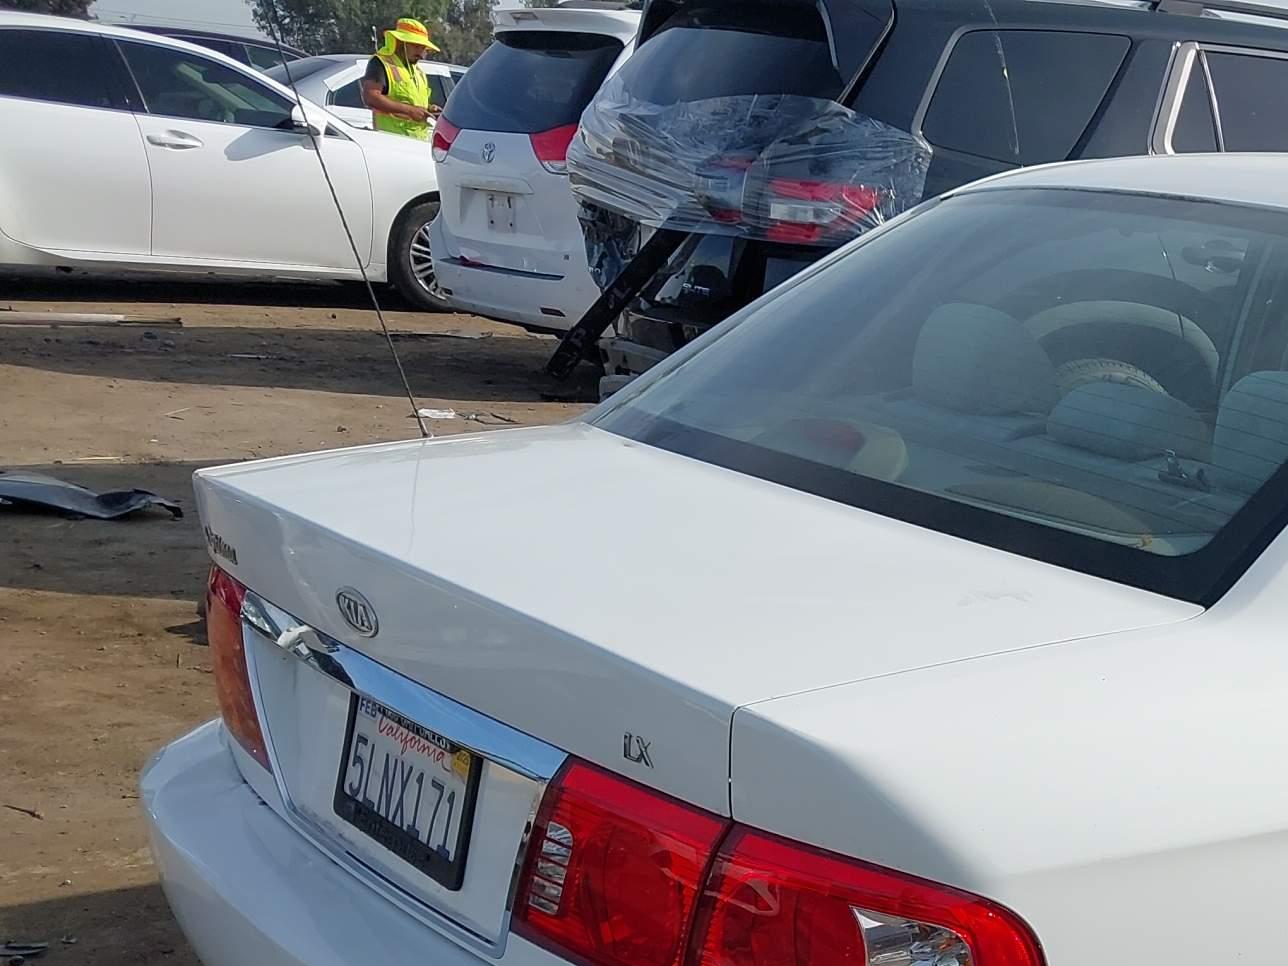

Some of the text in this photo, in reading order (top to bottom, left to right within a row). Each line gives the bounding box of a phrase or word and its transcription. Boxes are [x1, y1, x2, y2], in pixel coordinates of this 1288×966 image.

[339, 591, 376, 633] KIA
[359, 697, 378, 718] FEB
[376, 714, 452, 772] California
[623, 731, 655, 769] LX
[348, 733, 457, 862] 5LNX171
